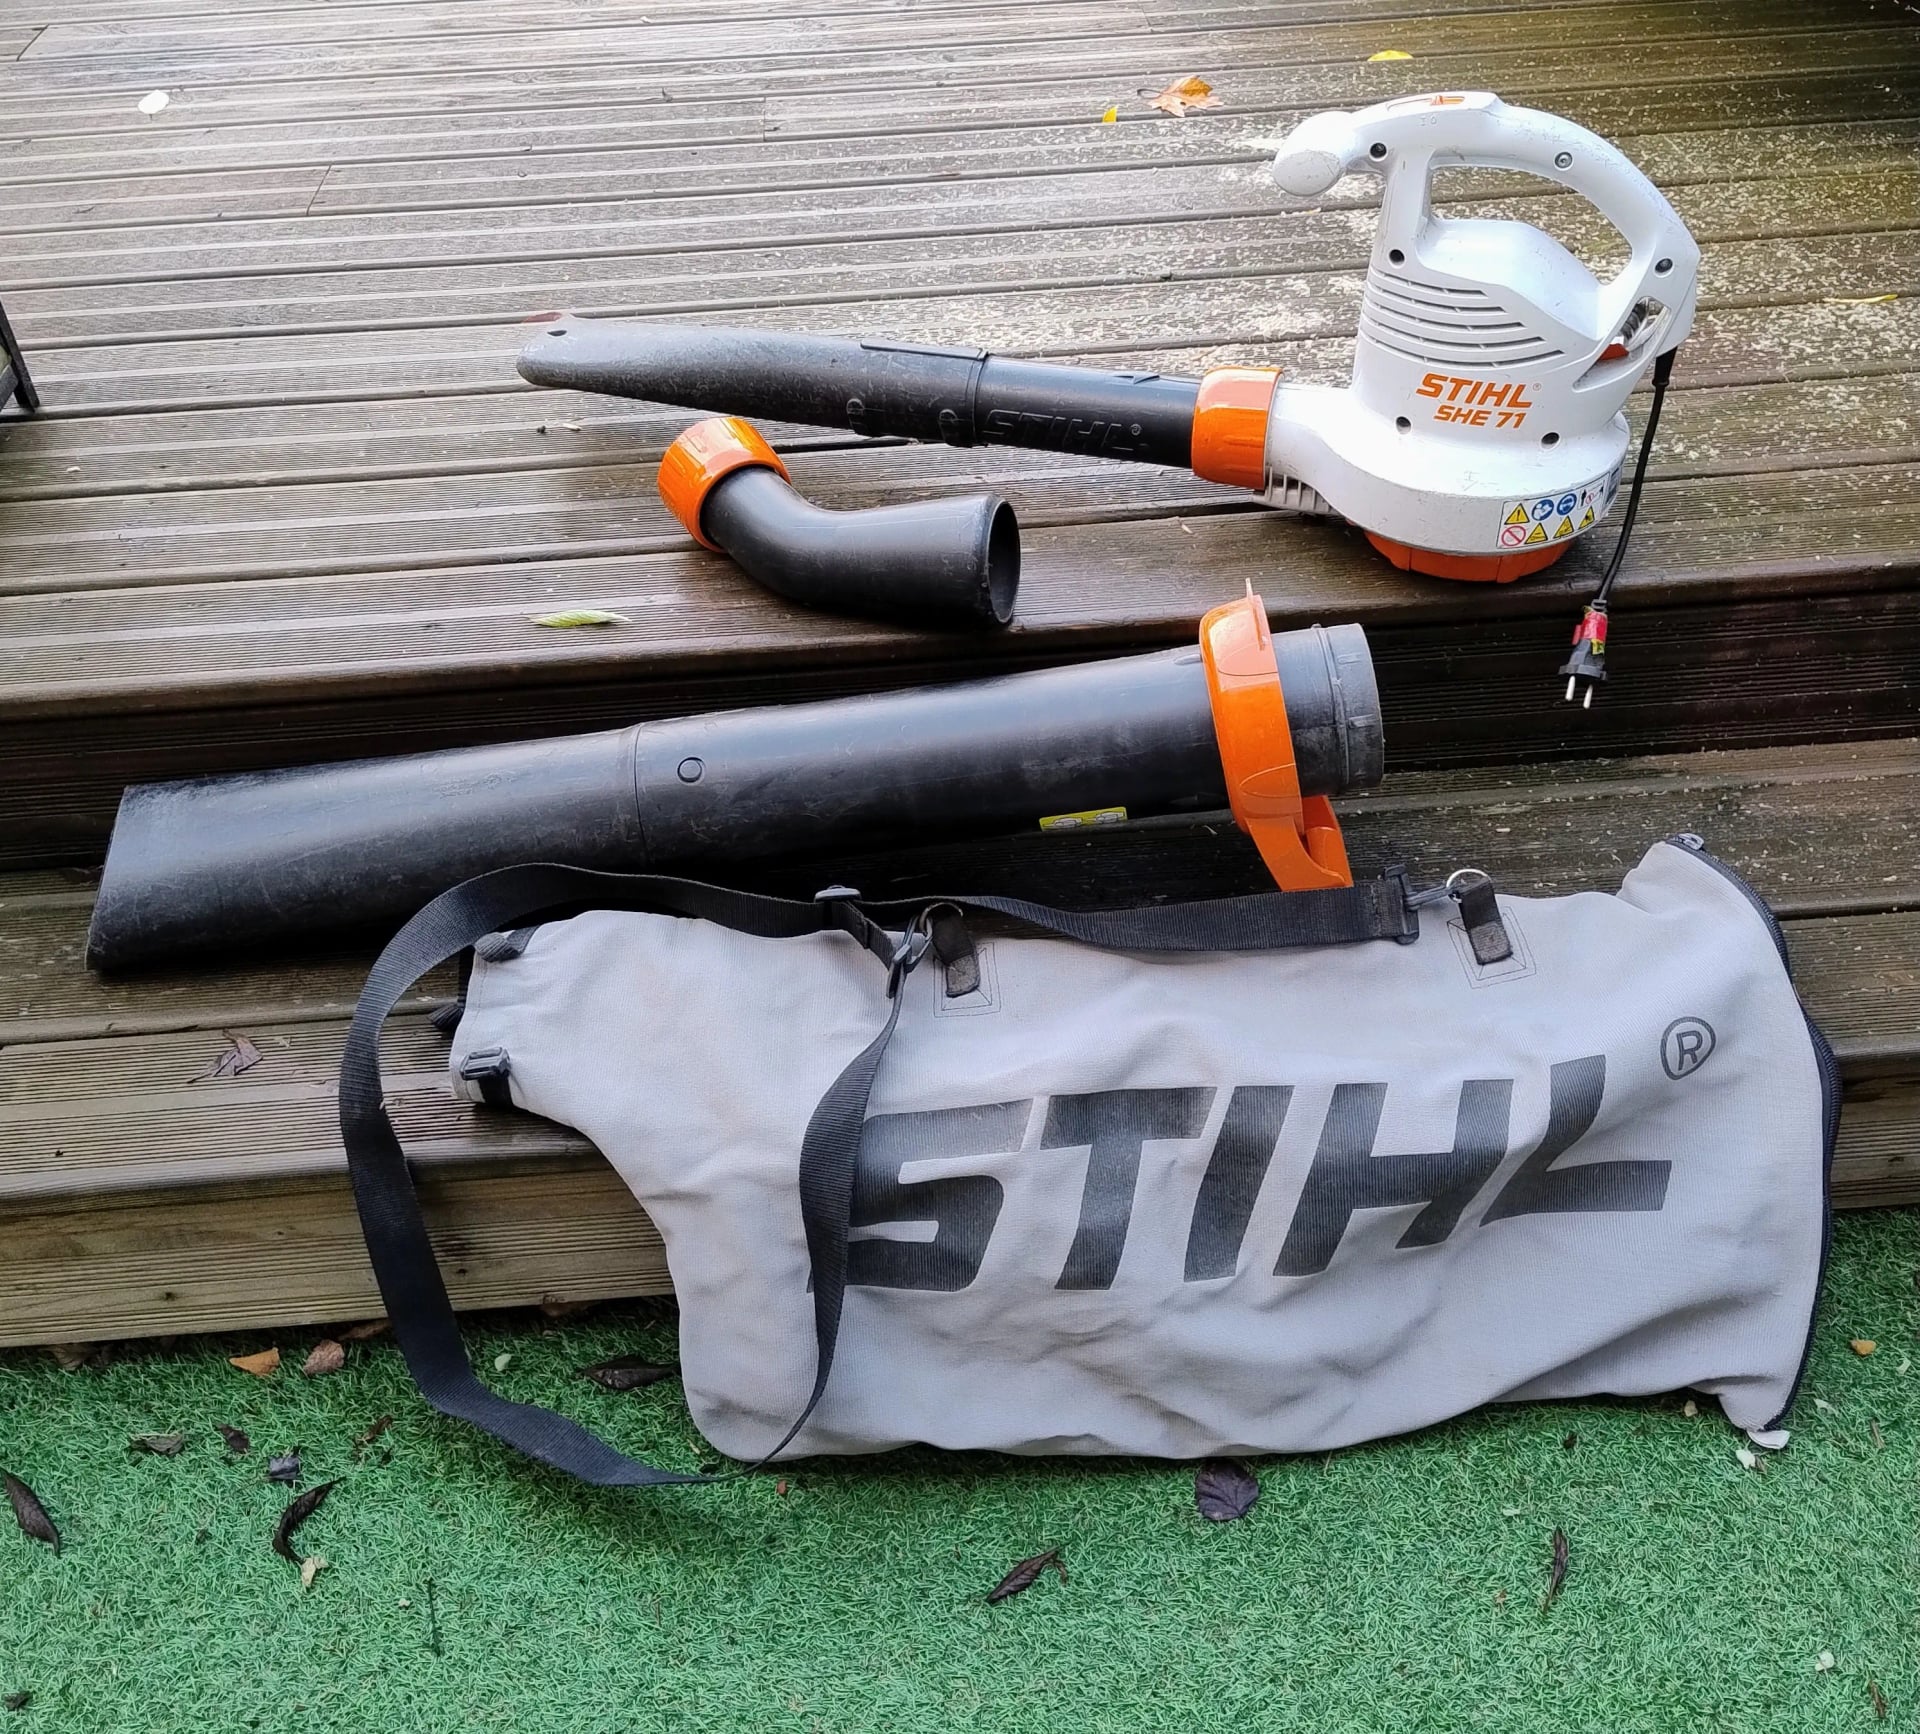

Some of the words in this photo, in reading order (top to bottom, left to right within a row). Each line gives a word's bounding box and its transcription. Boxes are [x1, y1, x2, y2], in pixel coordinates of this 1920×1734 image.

[1416, 372, 1532, 409] STIHL
[982, 408, 1135, 451] STIHL
[1433, 404, 1492, 427] SHE
[1495, 412, 1527, 429] 71
[806, 1054, 1673, 1293] STIHL
